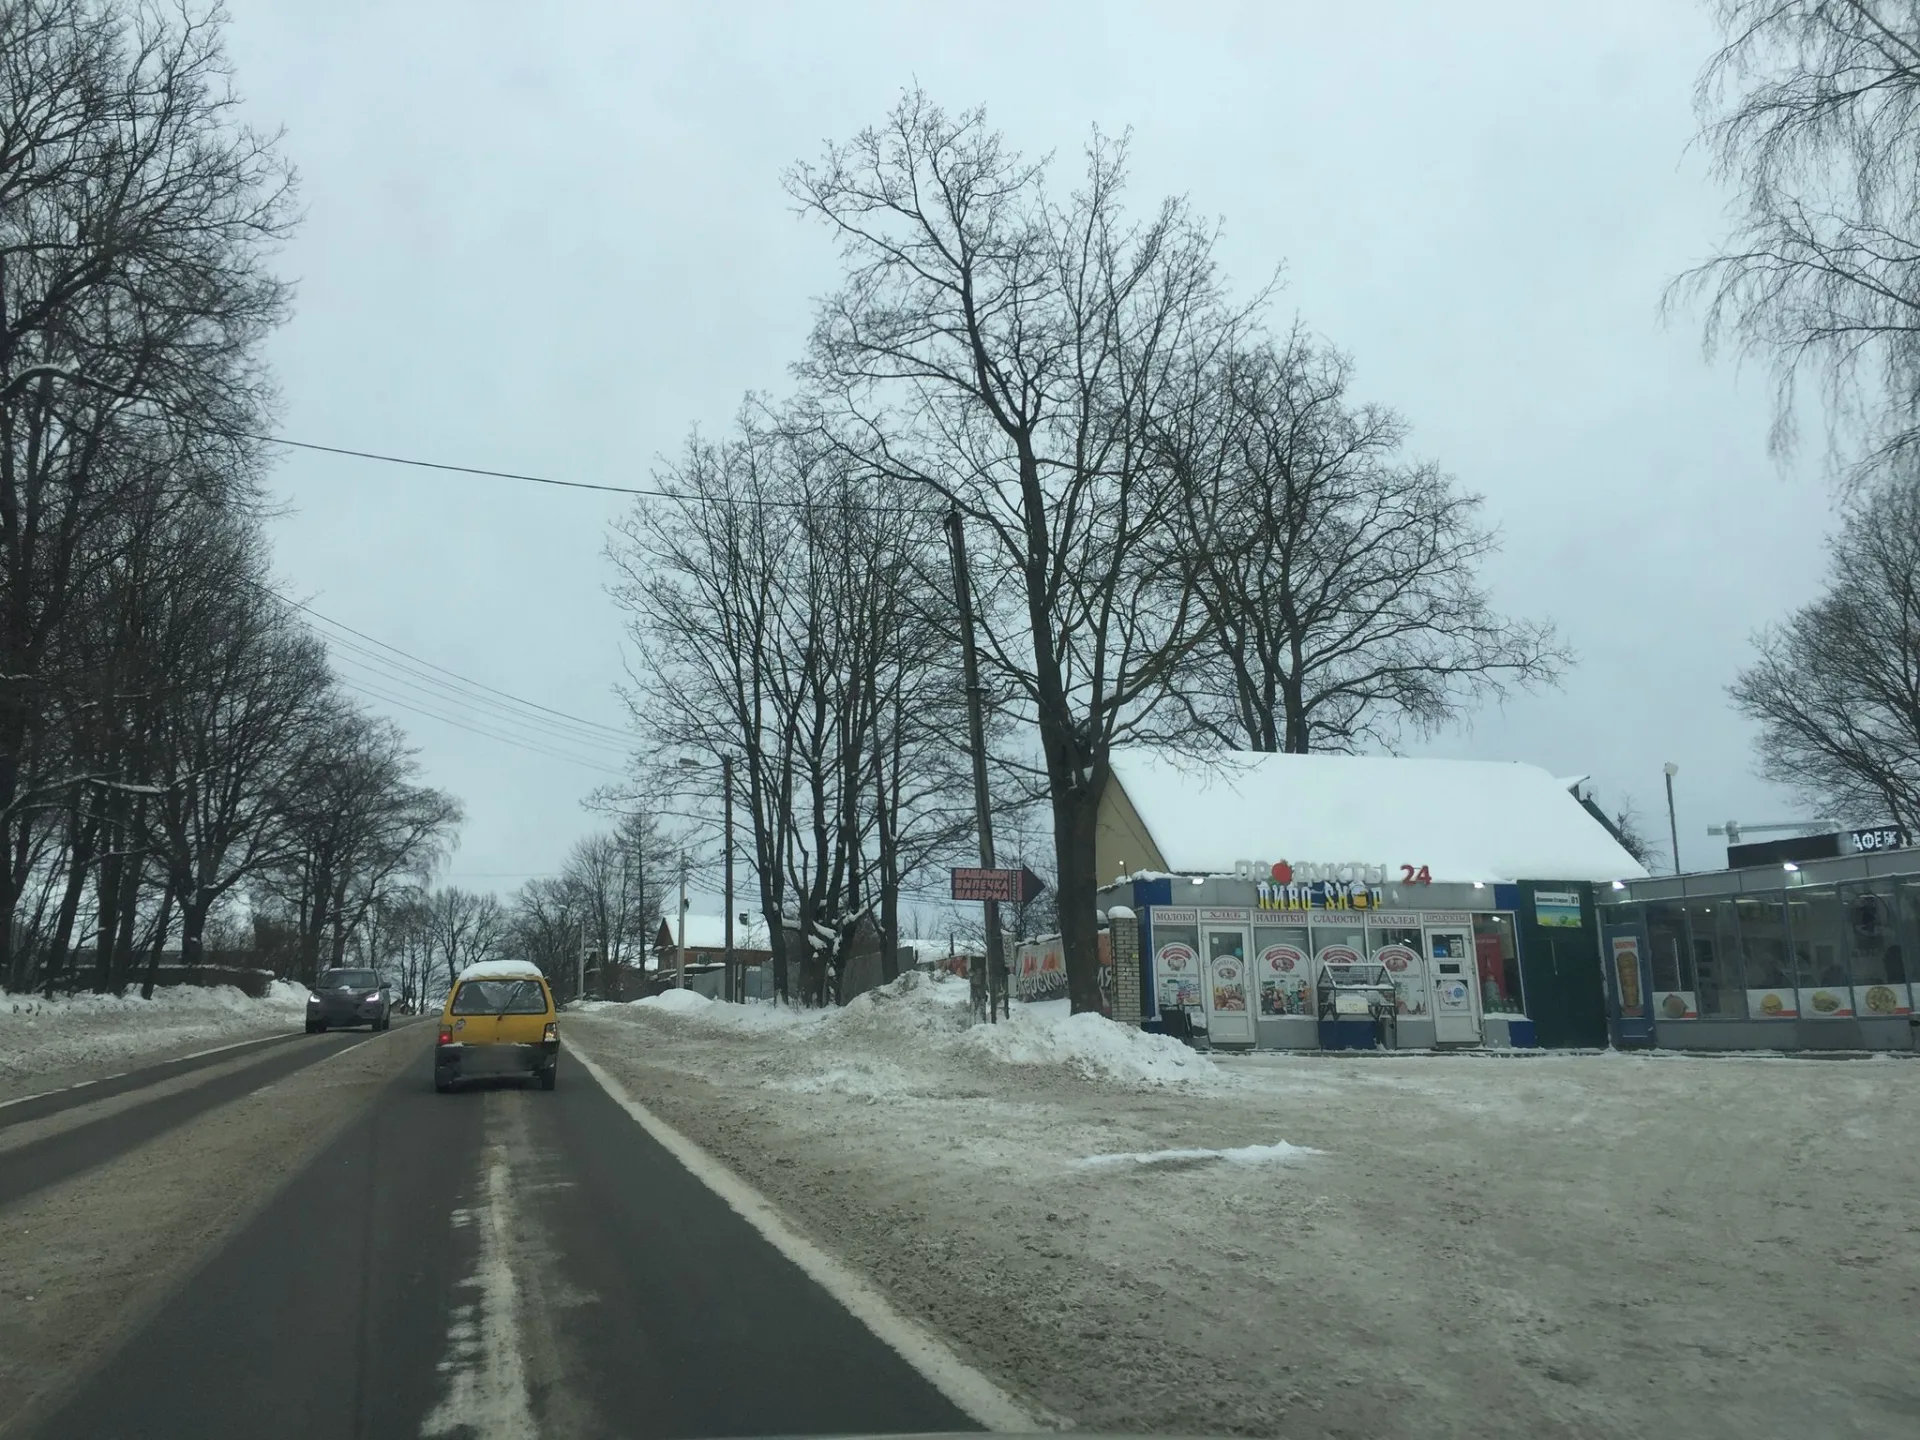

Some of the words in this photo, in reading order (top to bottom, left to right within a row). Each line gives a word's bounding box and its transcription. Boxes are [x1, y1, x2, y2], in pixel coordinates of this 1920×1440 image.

[1400, 864, 1433, 886] 24
[954, 879, 1009, 890] ВЫПЕЧКА
[954, 889, 1009, 900] ШАВЕРМА
[1257, 881, 1312, 911] ПИВО
[1155, 912, 1195, 923] МОЛОКО
[1209, 910, 1241, 919] ХЛЕБ
[1255, 913, 1306, 924] НАПИТКИ
[1313, 914, 1361, 925] СЛАДОСТИ
[1424, 913, 1467, 922] ПРОДУКТЫ
[1370, 915, 1417, 926] БАКАЛЕЯ
